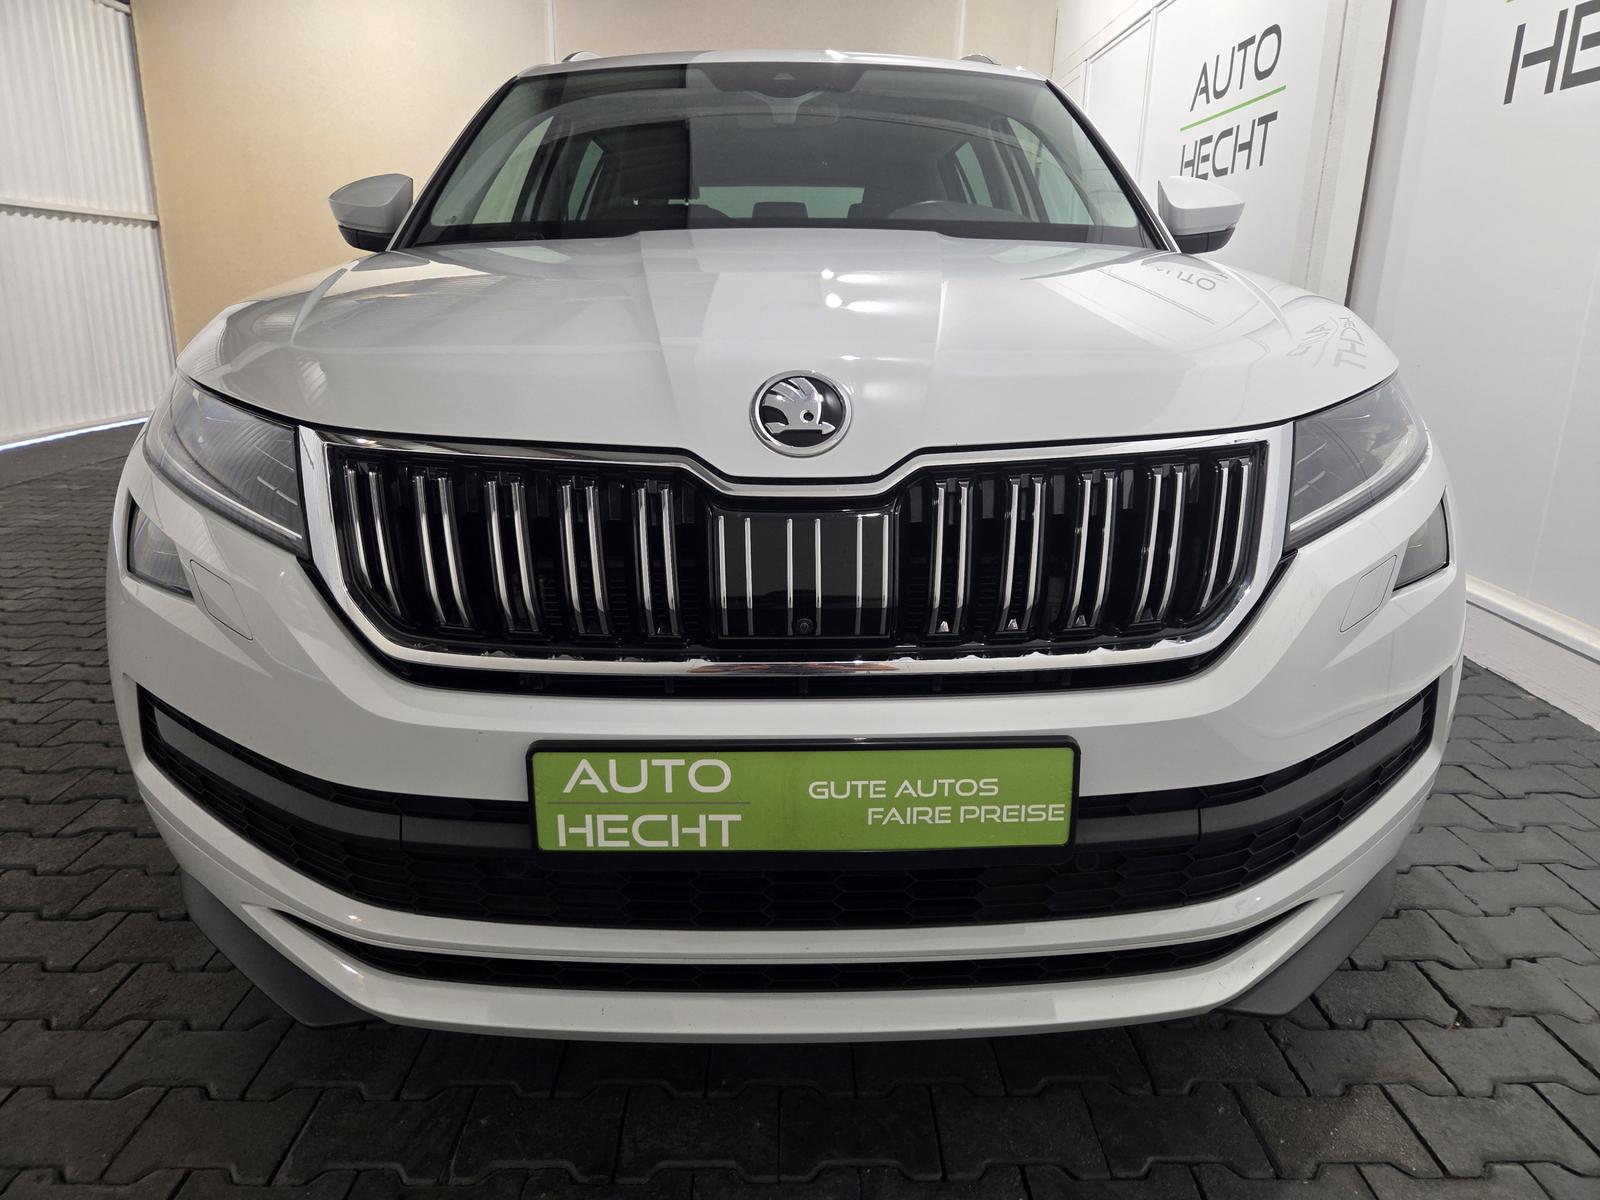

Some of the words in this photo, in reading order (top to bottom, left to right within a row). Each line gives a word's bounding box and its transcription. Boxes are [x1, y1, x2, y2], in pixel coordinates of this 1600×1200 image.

[1189, 23, 1282, 112] AUTO
[1180, 110, 1278, 180] HECHT
[563, 759, 732, 794] AUTO
[808, 780, 887, 800] GUTE
[894, 778, 999, 798] AUTOS
[557, 814, 742, 848] HECHT
[867, 806, 952, 826] FAIRE
[959, 803, 1066, 824] PREISE
